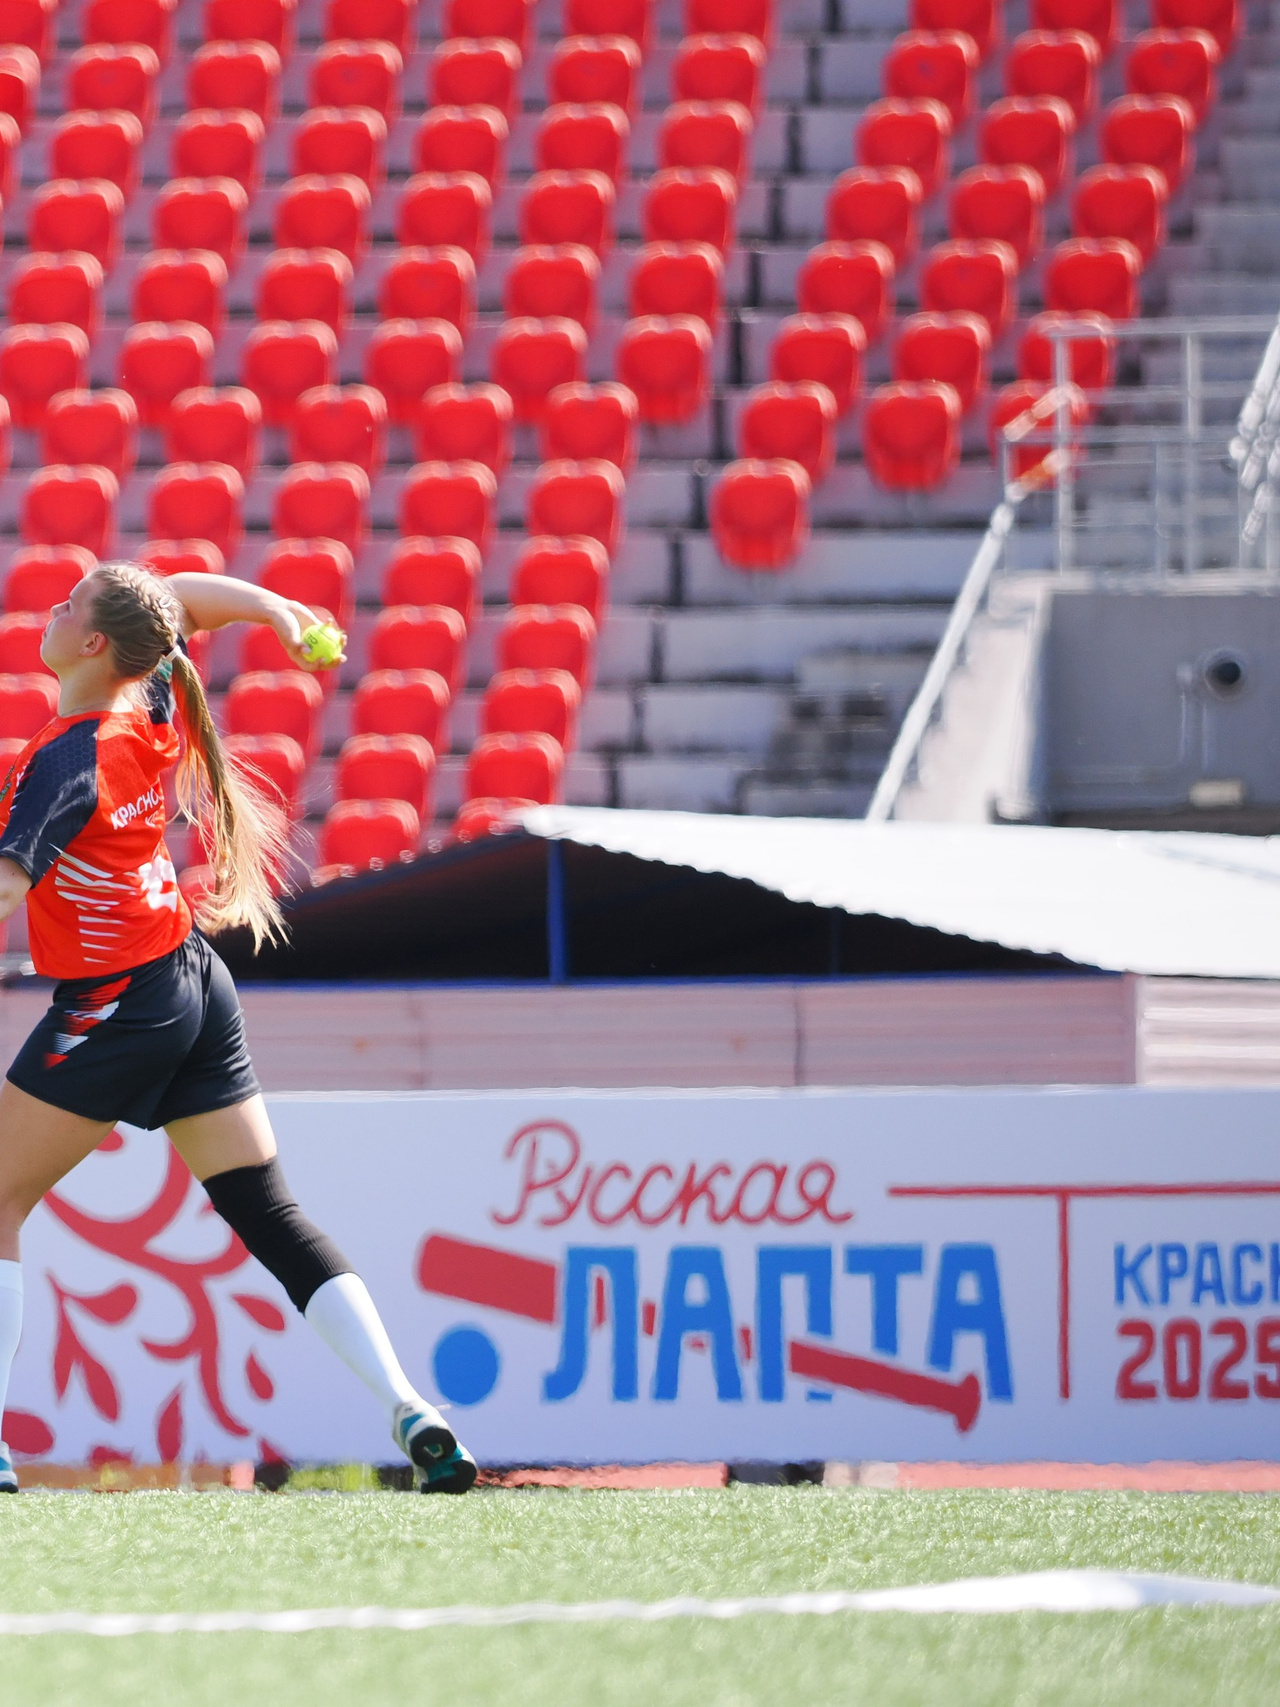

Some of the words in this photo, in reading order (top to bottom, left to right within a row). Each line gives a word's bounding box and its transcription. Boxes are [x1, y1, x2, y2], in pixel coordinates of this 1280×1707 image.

[491, 1119, 855, 1227] Русская
[1113, 1241, 1280, 1308] КРАС
[542, 1242, 1016, 1405] ЛАПТА
[1116, 1318, 1280, 1401] 2025
